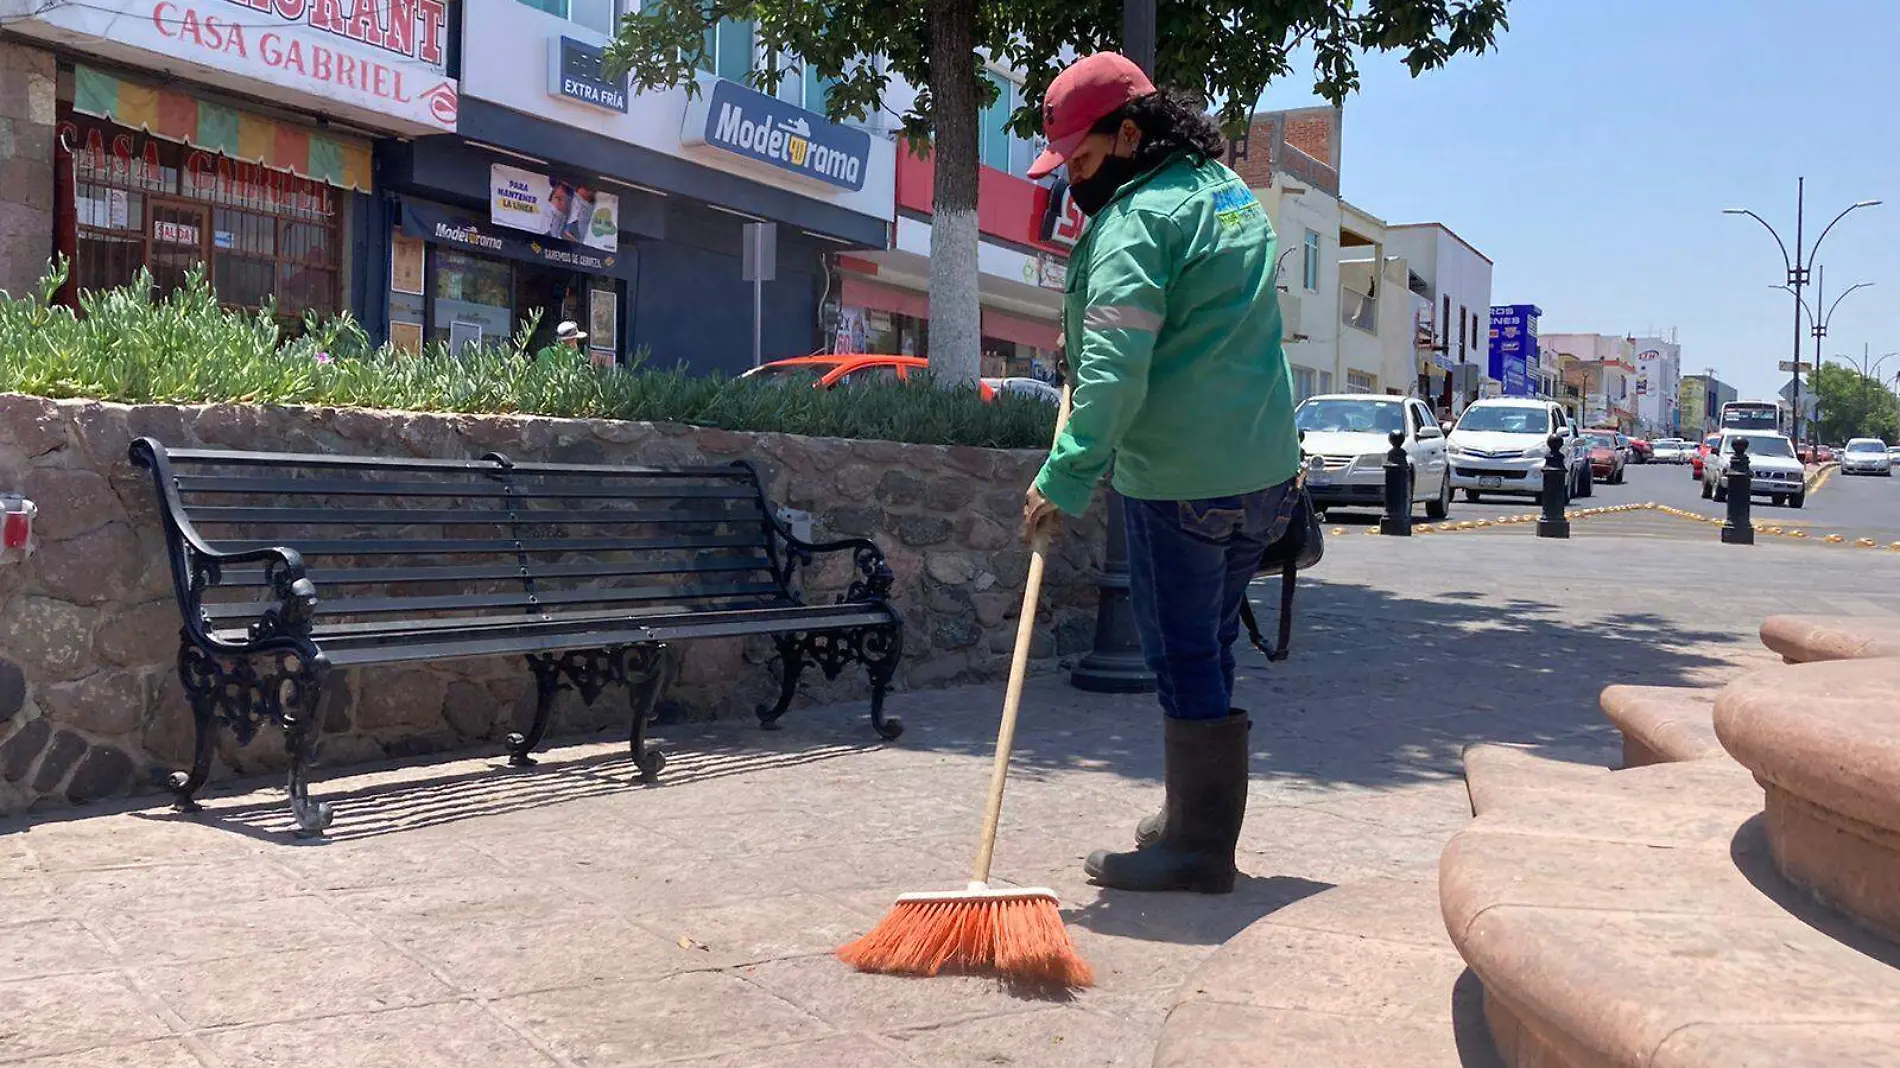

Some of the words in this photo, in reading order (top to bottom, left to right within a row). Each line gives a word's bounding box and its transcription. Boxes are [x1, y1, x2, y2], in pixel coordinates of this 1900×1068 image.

[152, 2, 249, 60] CASA
[259, 33, 412, 104] GABRIEL
[564, 79, 599, 102] EXTRA
[600, 89, 624, 109] FRÍA
[156, 223, 193, 241] SALDA
